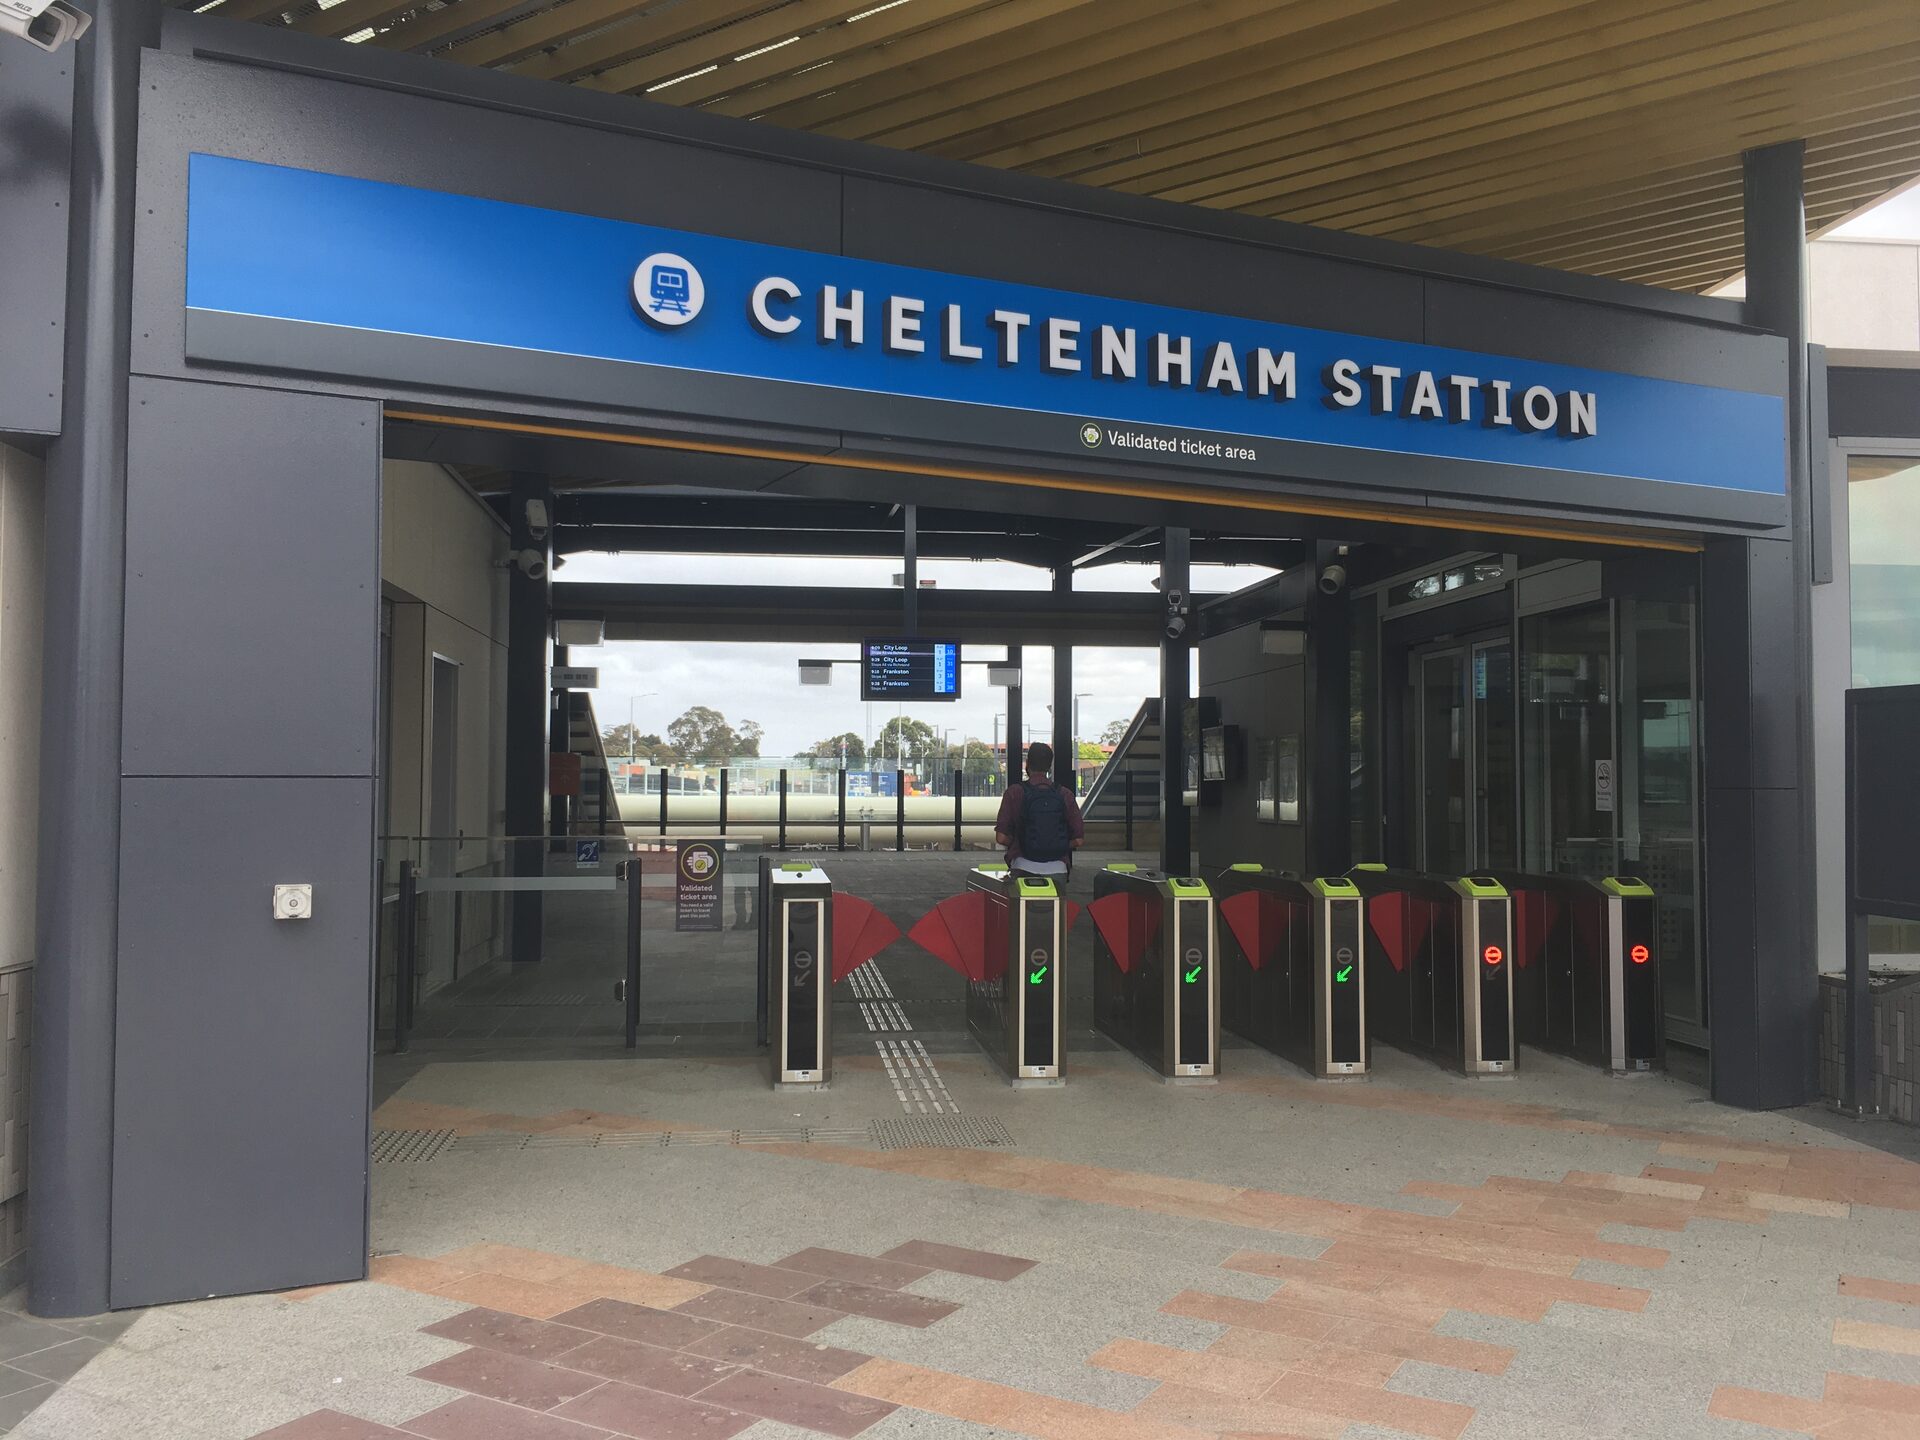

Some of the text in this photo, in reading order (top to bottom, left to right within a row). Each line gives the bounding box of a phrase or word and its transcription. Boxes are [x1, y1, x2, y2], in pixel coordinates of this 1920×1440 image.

[748, 276, 1598, 438] CHELTENHAM STATION
[1107, 430, 1257, 461] Validated ticket area
